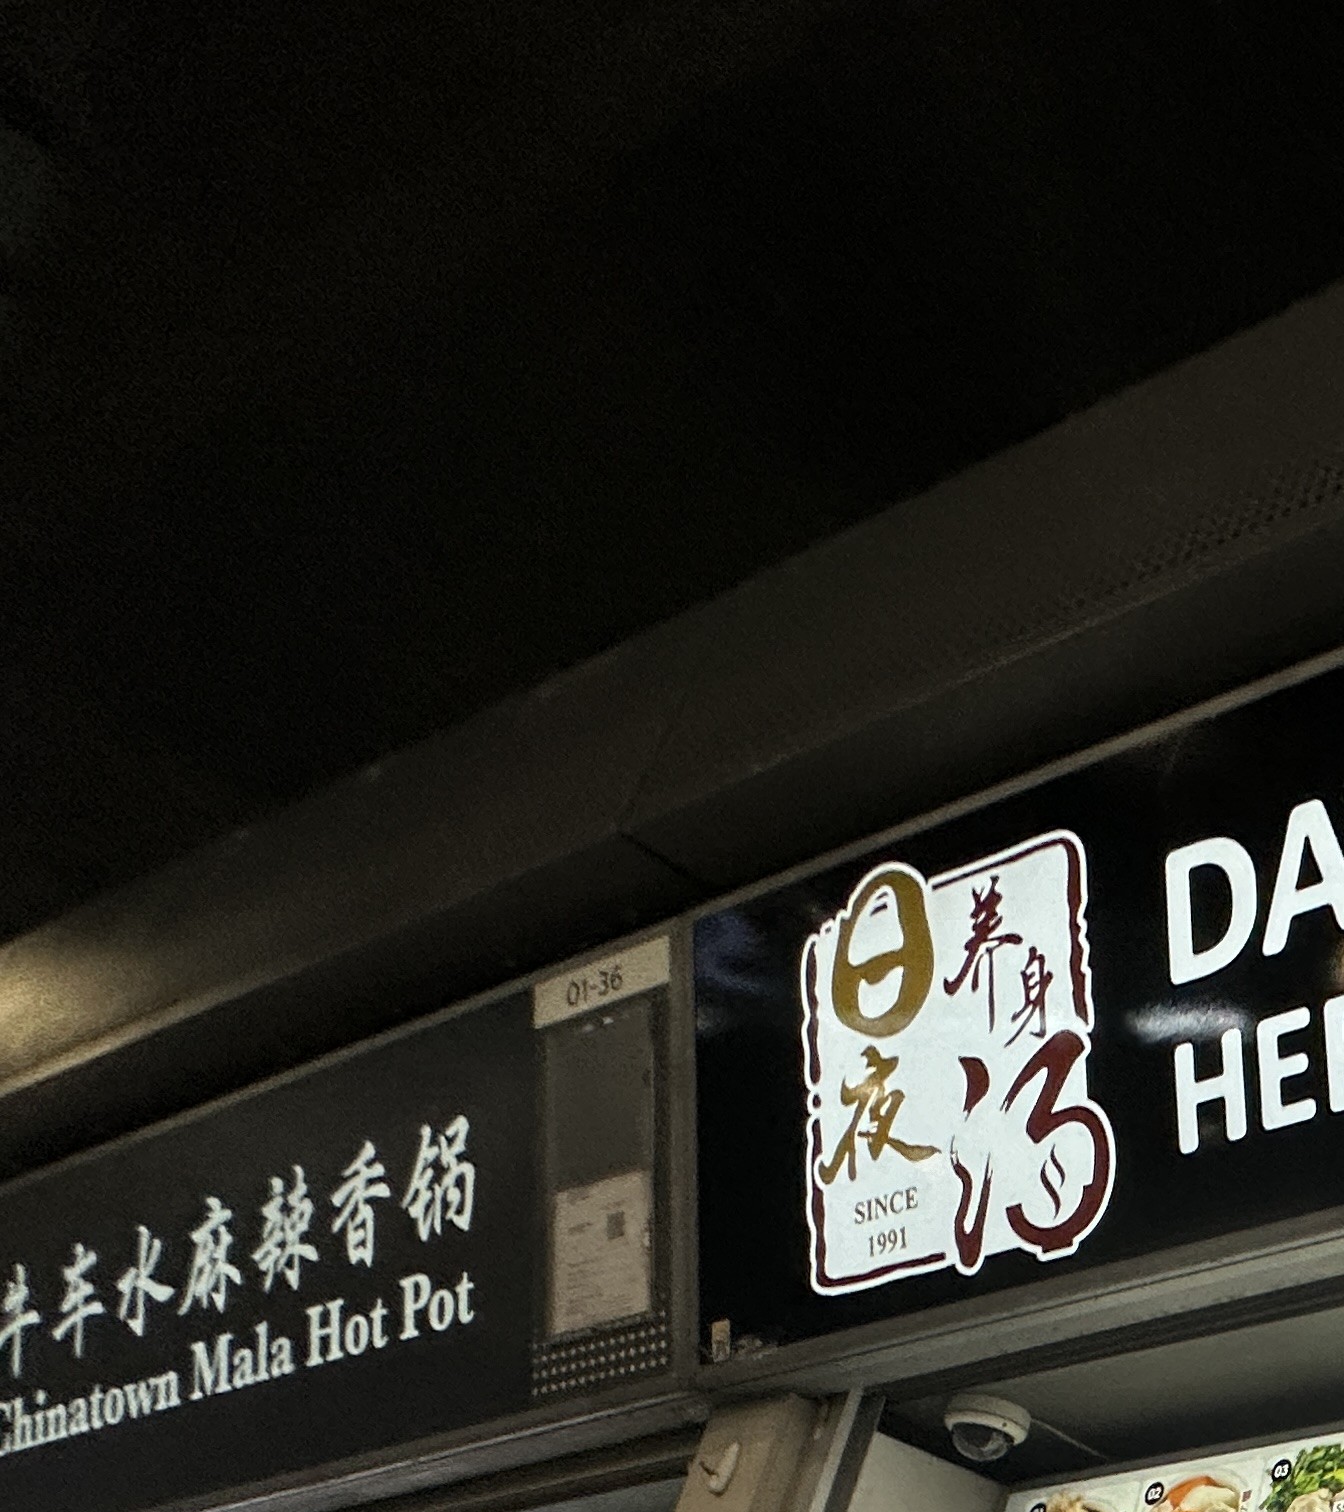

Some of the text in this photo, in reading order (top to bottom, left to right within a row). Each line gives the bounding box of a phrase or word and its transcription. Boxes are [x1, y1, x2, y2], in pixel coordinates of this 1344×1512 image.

[567, 962, 624, 1006] 01-36
[853, 1186, 919, 1225] SINCE
[867, 1226, 909, 1258] 1991
[190, 1321, 294, 1400] Mala
[306, 1299, 388, 1366] Hot
[400, 1272, 475, 1340] Pot
[1274, 1464, 1289, 1478] 03
